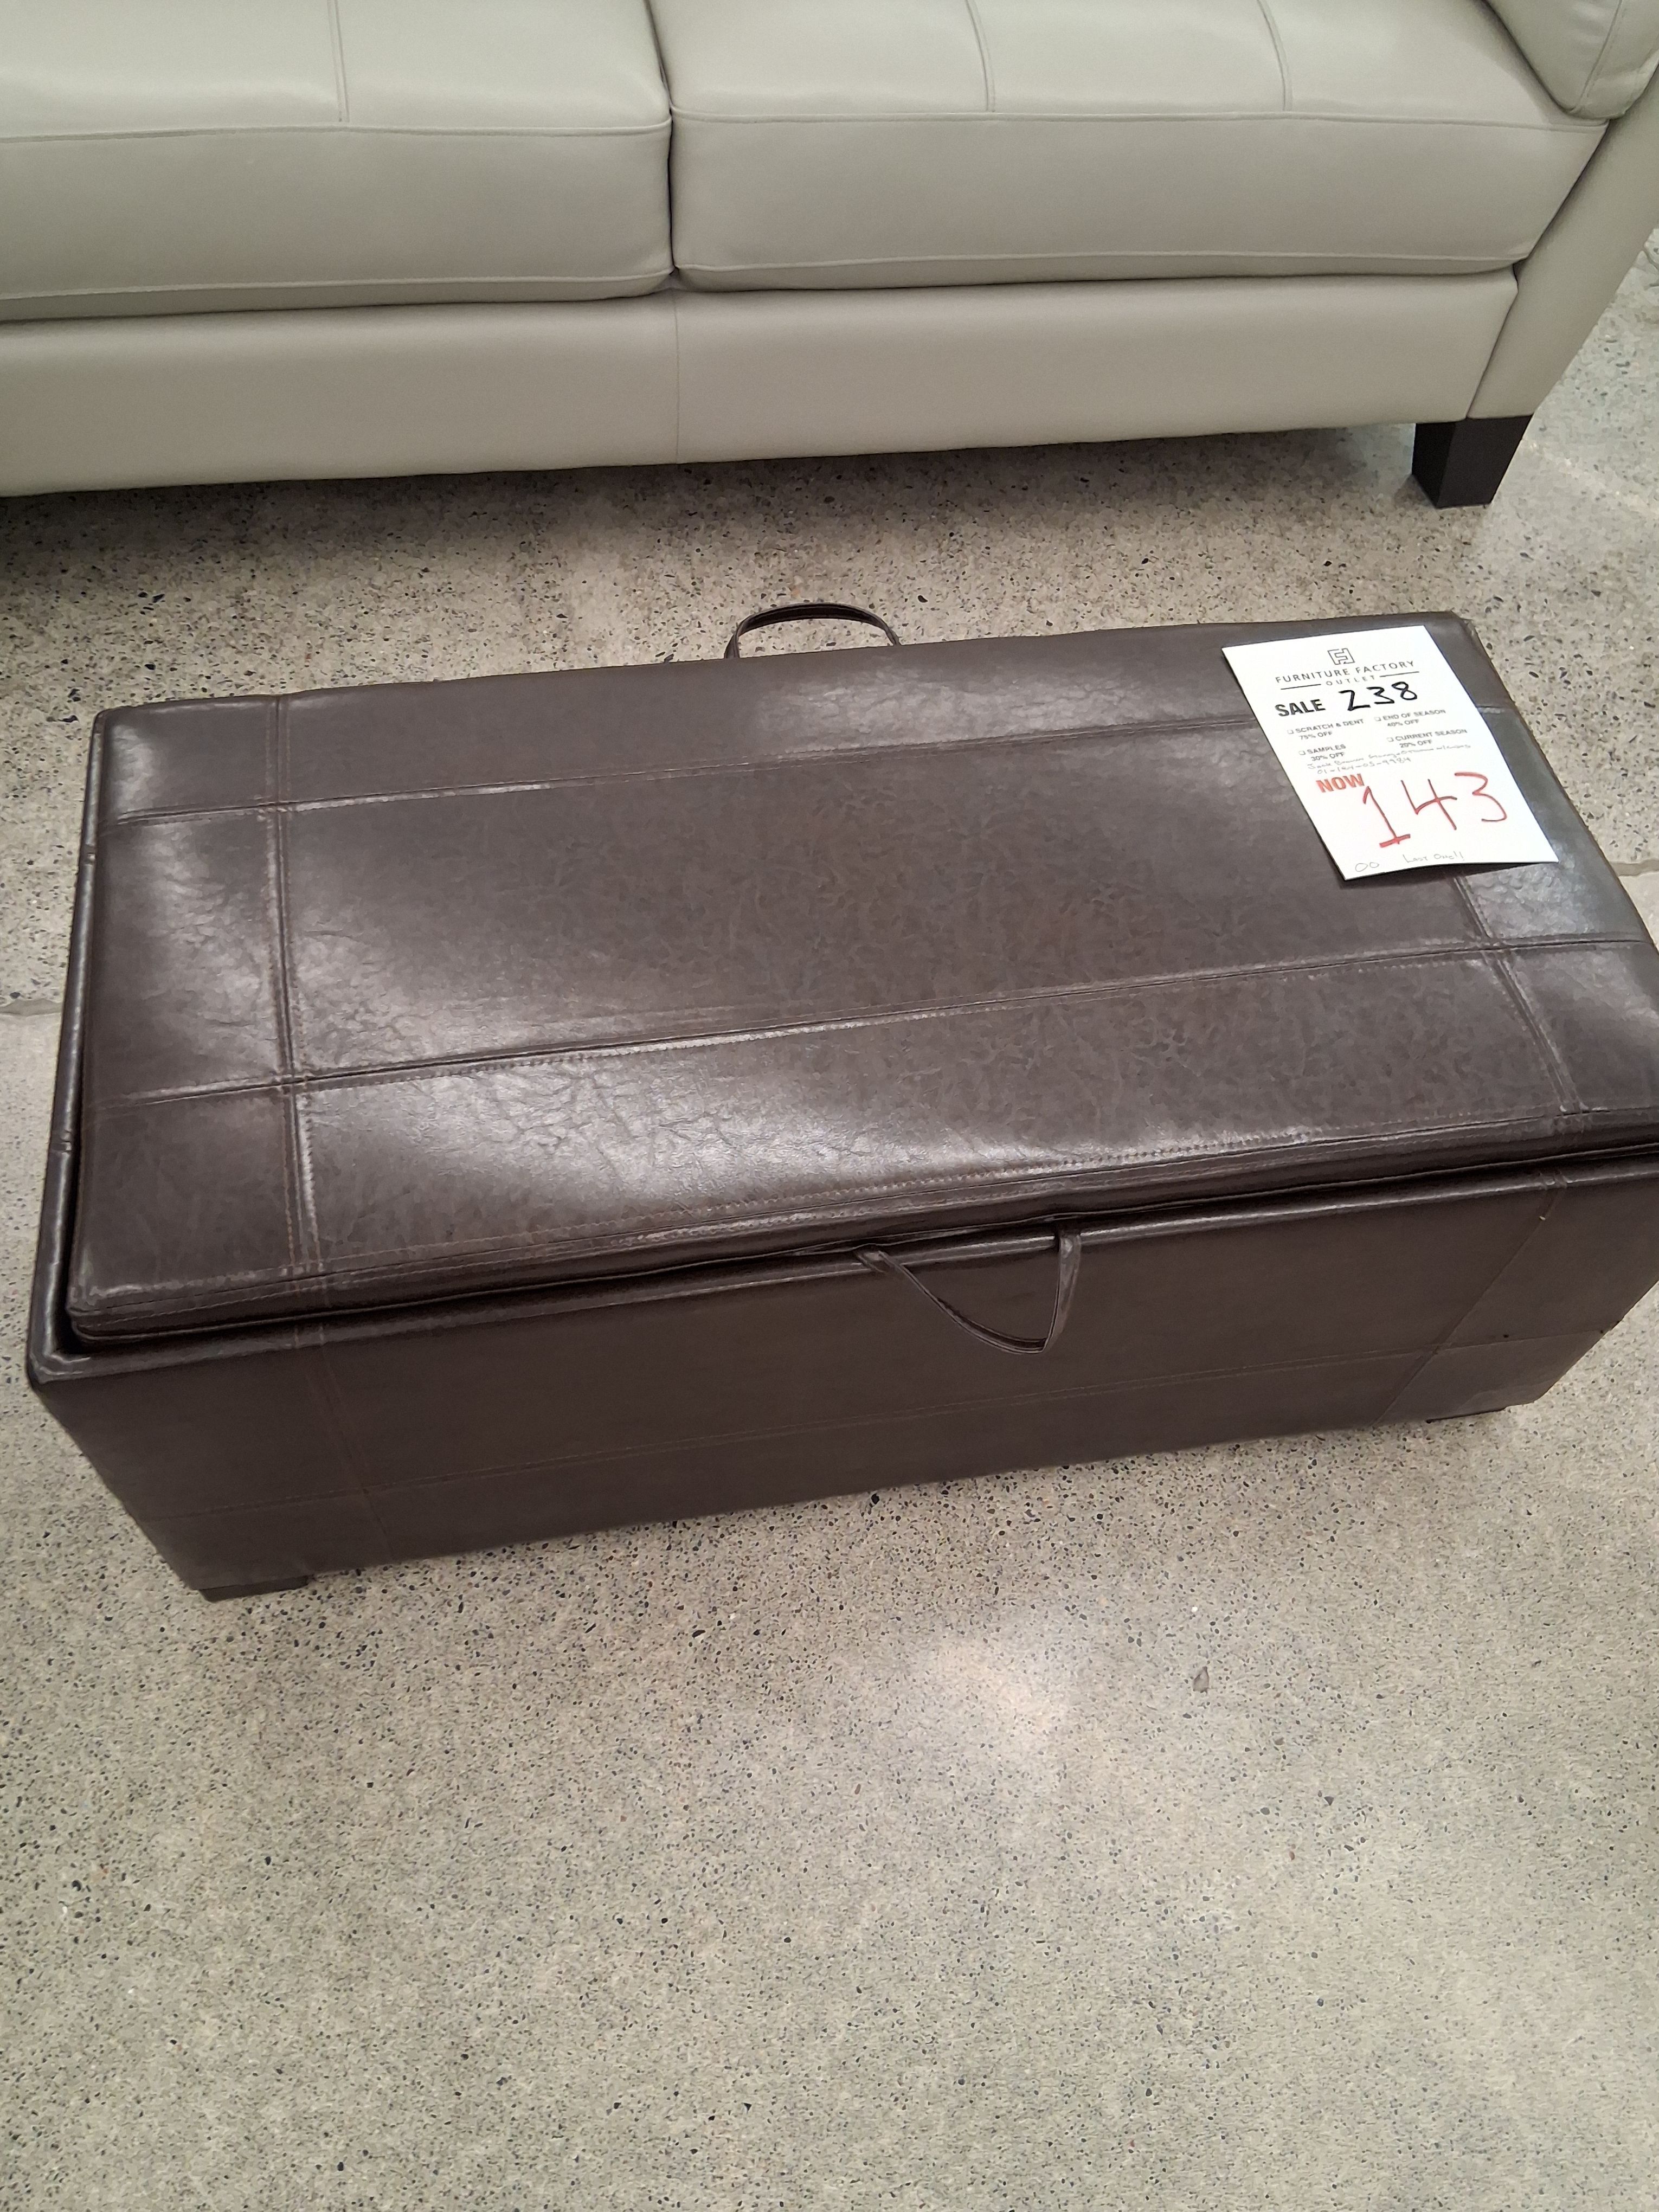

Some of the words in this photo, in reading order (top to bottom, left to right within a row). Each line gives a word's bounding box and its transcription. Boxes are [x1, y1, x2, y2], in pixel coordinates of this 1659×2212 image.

[1275, 668, 1350, 683] FURNITURE
[1355, 660, 1414, 673] FACTORY
[1326, 675, 1375, 686] OUTLET
[1275, 699, 1326, 717] SALE
[1338, 681, 1418, 711] 238
[1295, 724, 1334, 733] SCRATCH
[1395, 732, 1433, 741] CURRENT
[1307, 744, 1346, 754] SAMPLES
[1316, 773, 1365, 793] NOW
[1362, 772, 1507, 848] 143
